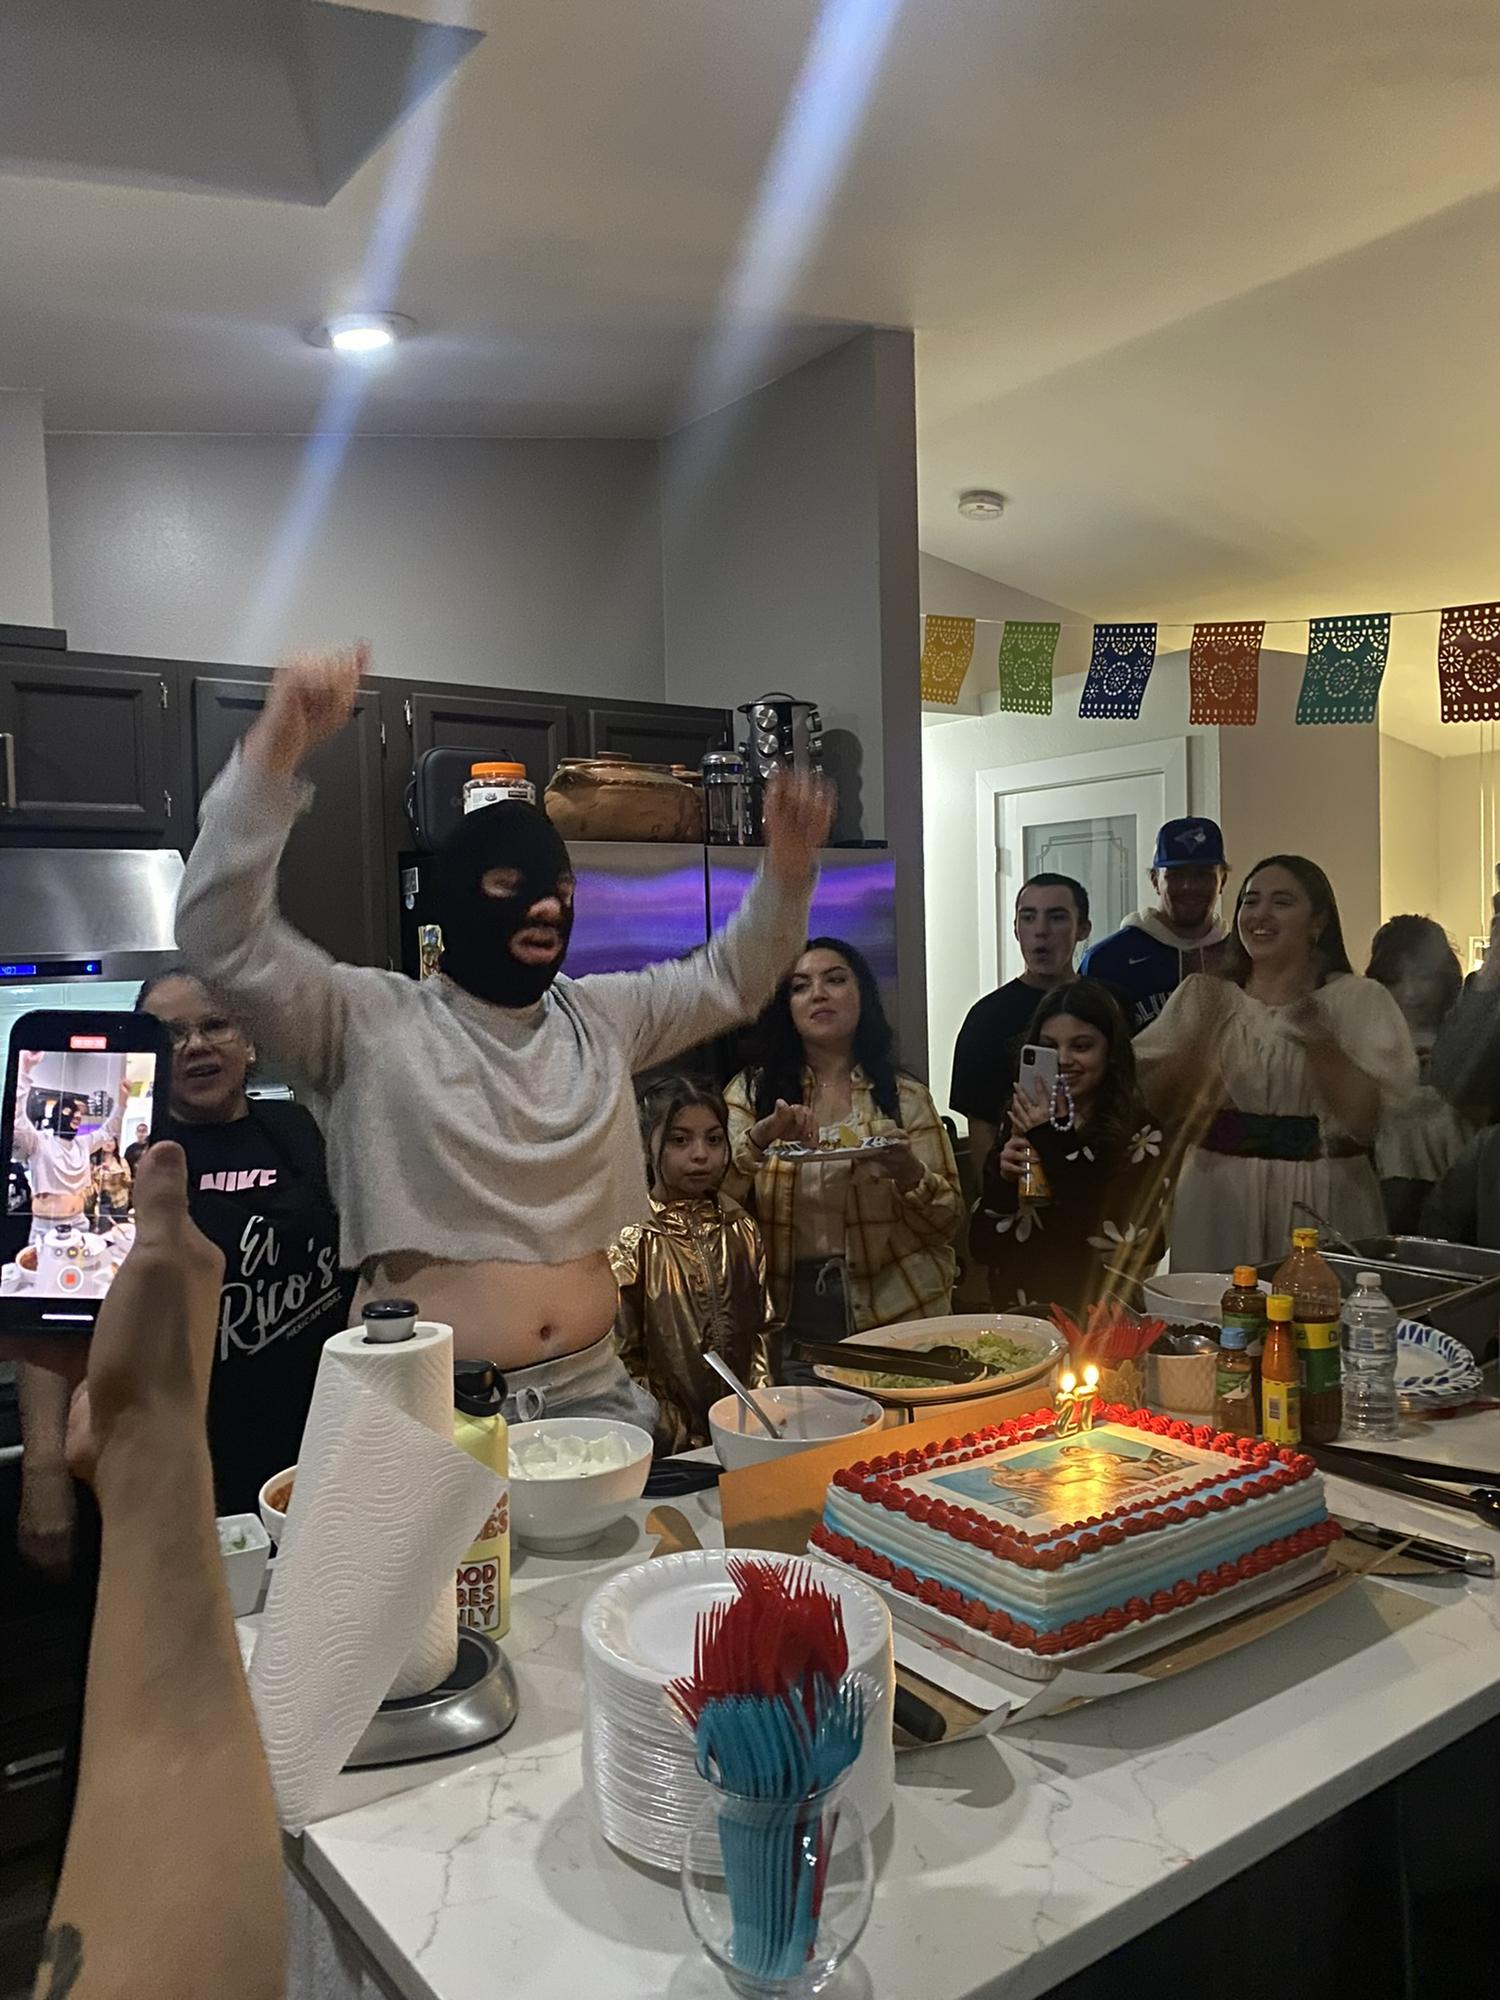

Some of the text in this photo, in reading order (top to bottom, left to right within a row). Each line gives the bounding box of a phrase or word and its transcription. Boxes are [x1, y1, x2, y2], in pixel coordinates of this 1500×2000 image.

[199, 1168, 277, 1192] NIKE
[239, 1215, 281, 1277] El
[218, 1237, 337, 1361] Rico's
[456, 1564, 497, 1587] OOD
[456, 1584, 495, 1608] BES
[457, 1604, 496, 1629] NLY
